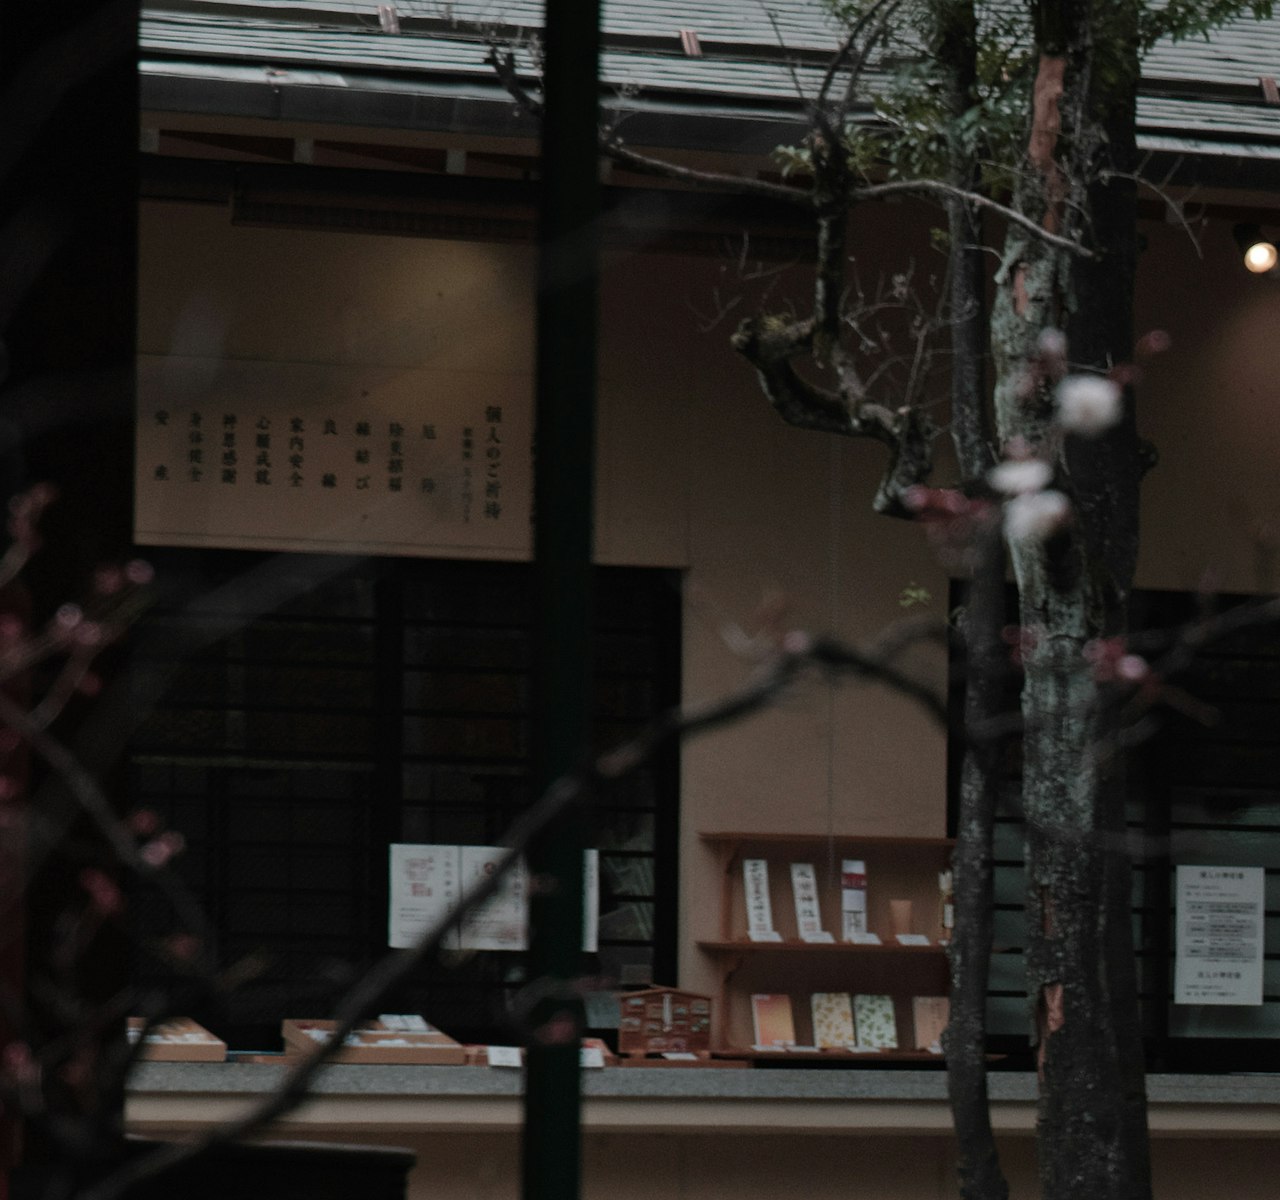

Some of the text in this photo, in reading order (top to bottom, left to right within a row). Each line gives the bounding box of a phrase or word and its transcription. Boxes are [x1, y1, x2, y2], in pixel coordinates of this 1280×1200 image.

[255, 416, 272, 485] 心願成就
[289, 416, 305, 487] 家内安全
